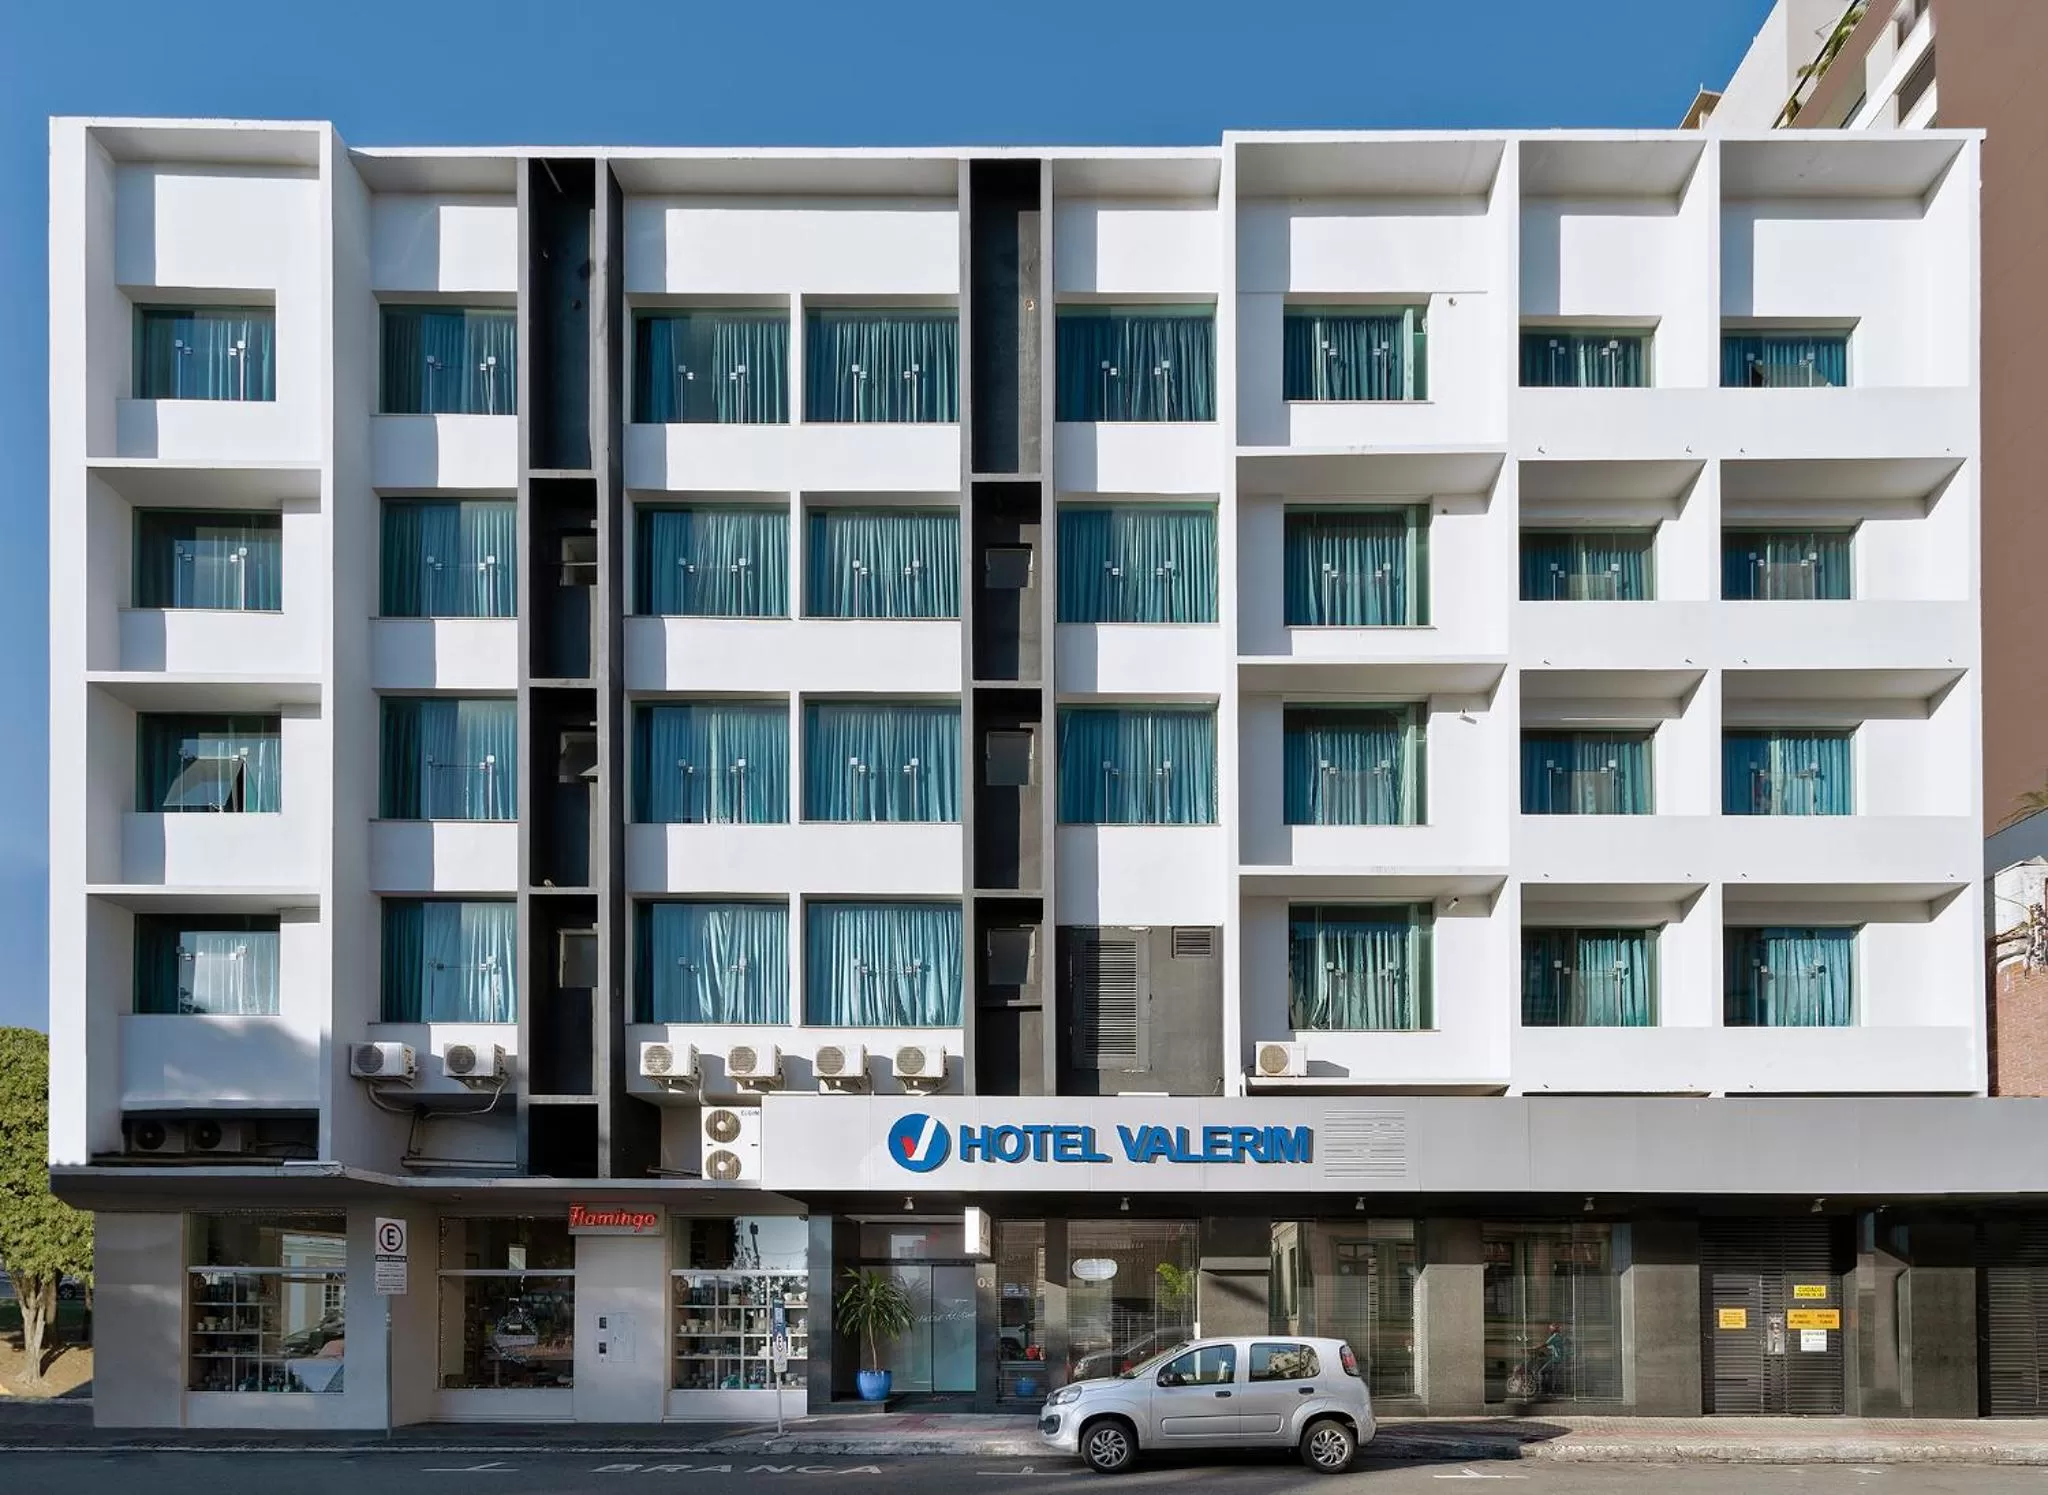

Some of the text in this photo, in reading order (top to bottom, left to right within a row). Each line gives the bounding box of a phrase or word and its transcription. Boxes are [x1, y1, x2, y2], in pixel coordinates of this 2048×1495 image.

[960, 1124, 1314, 1163] HOTEL VALERIM
[568, 1202, 656, 1232] Flamingo
[387, 1228, 396, 1246] E
[977, 1277, 995, 1289] 03
[588, 1463, 883, 1474] BRANCA
